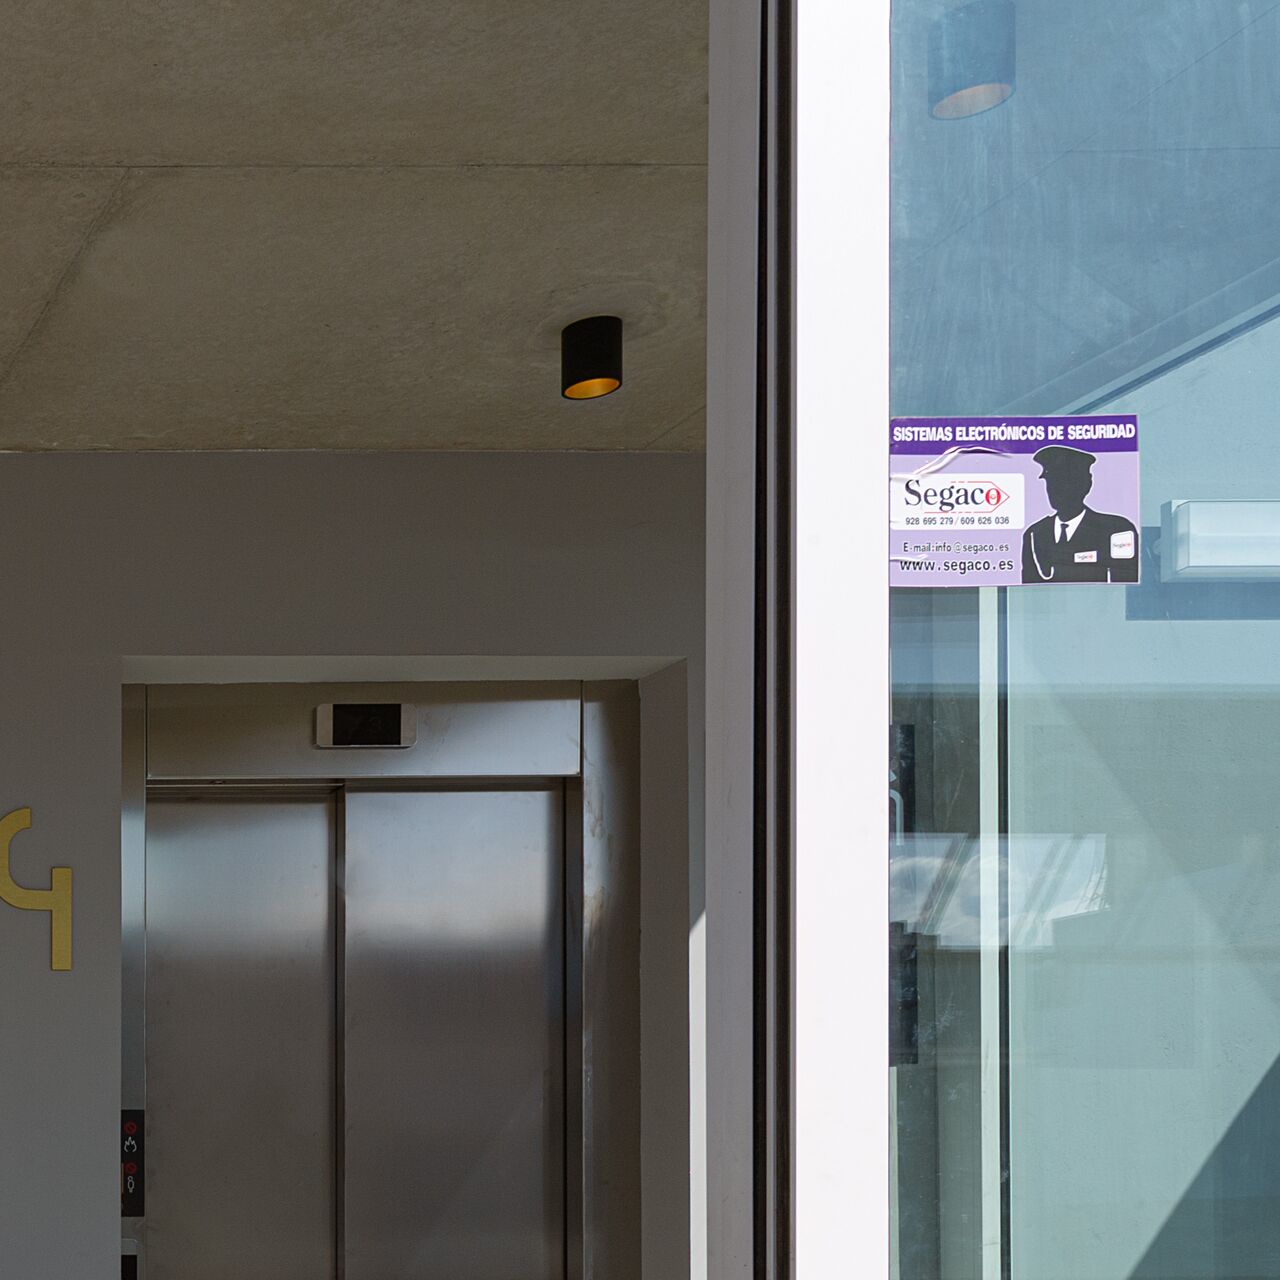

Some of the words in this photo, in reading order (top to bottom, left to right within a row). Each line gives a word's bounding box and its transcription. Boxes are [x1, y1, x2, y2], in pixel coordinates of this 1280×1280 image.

[893, 426, 953, 442] SISTEMAS
[955, 424, 1044, 441] ELECTRÓNICOS
[1048, 425, 1064, 440] DE
[1067, 424, 1136, 440] SEGURIDAD
[904, 479, 1002, 511] Segaco
[906, 517, 920, 525] 928
[923, 517, 937, 525] 695
[978, 517, 992, 525] 626
[995, 517, 1009, 525] 036
[900, 560, 1014, 575] www.segaco.es
